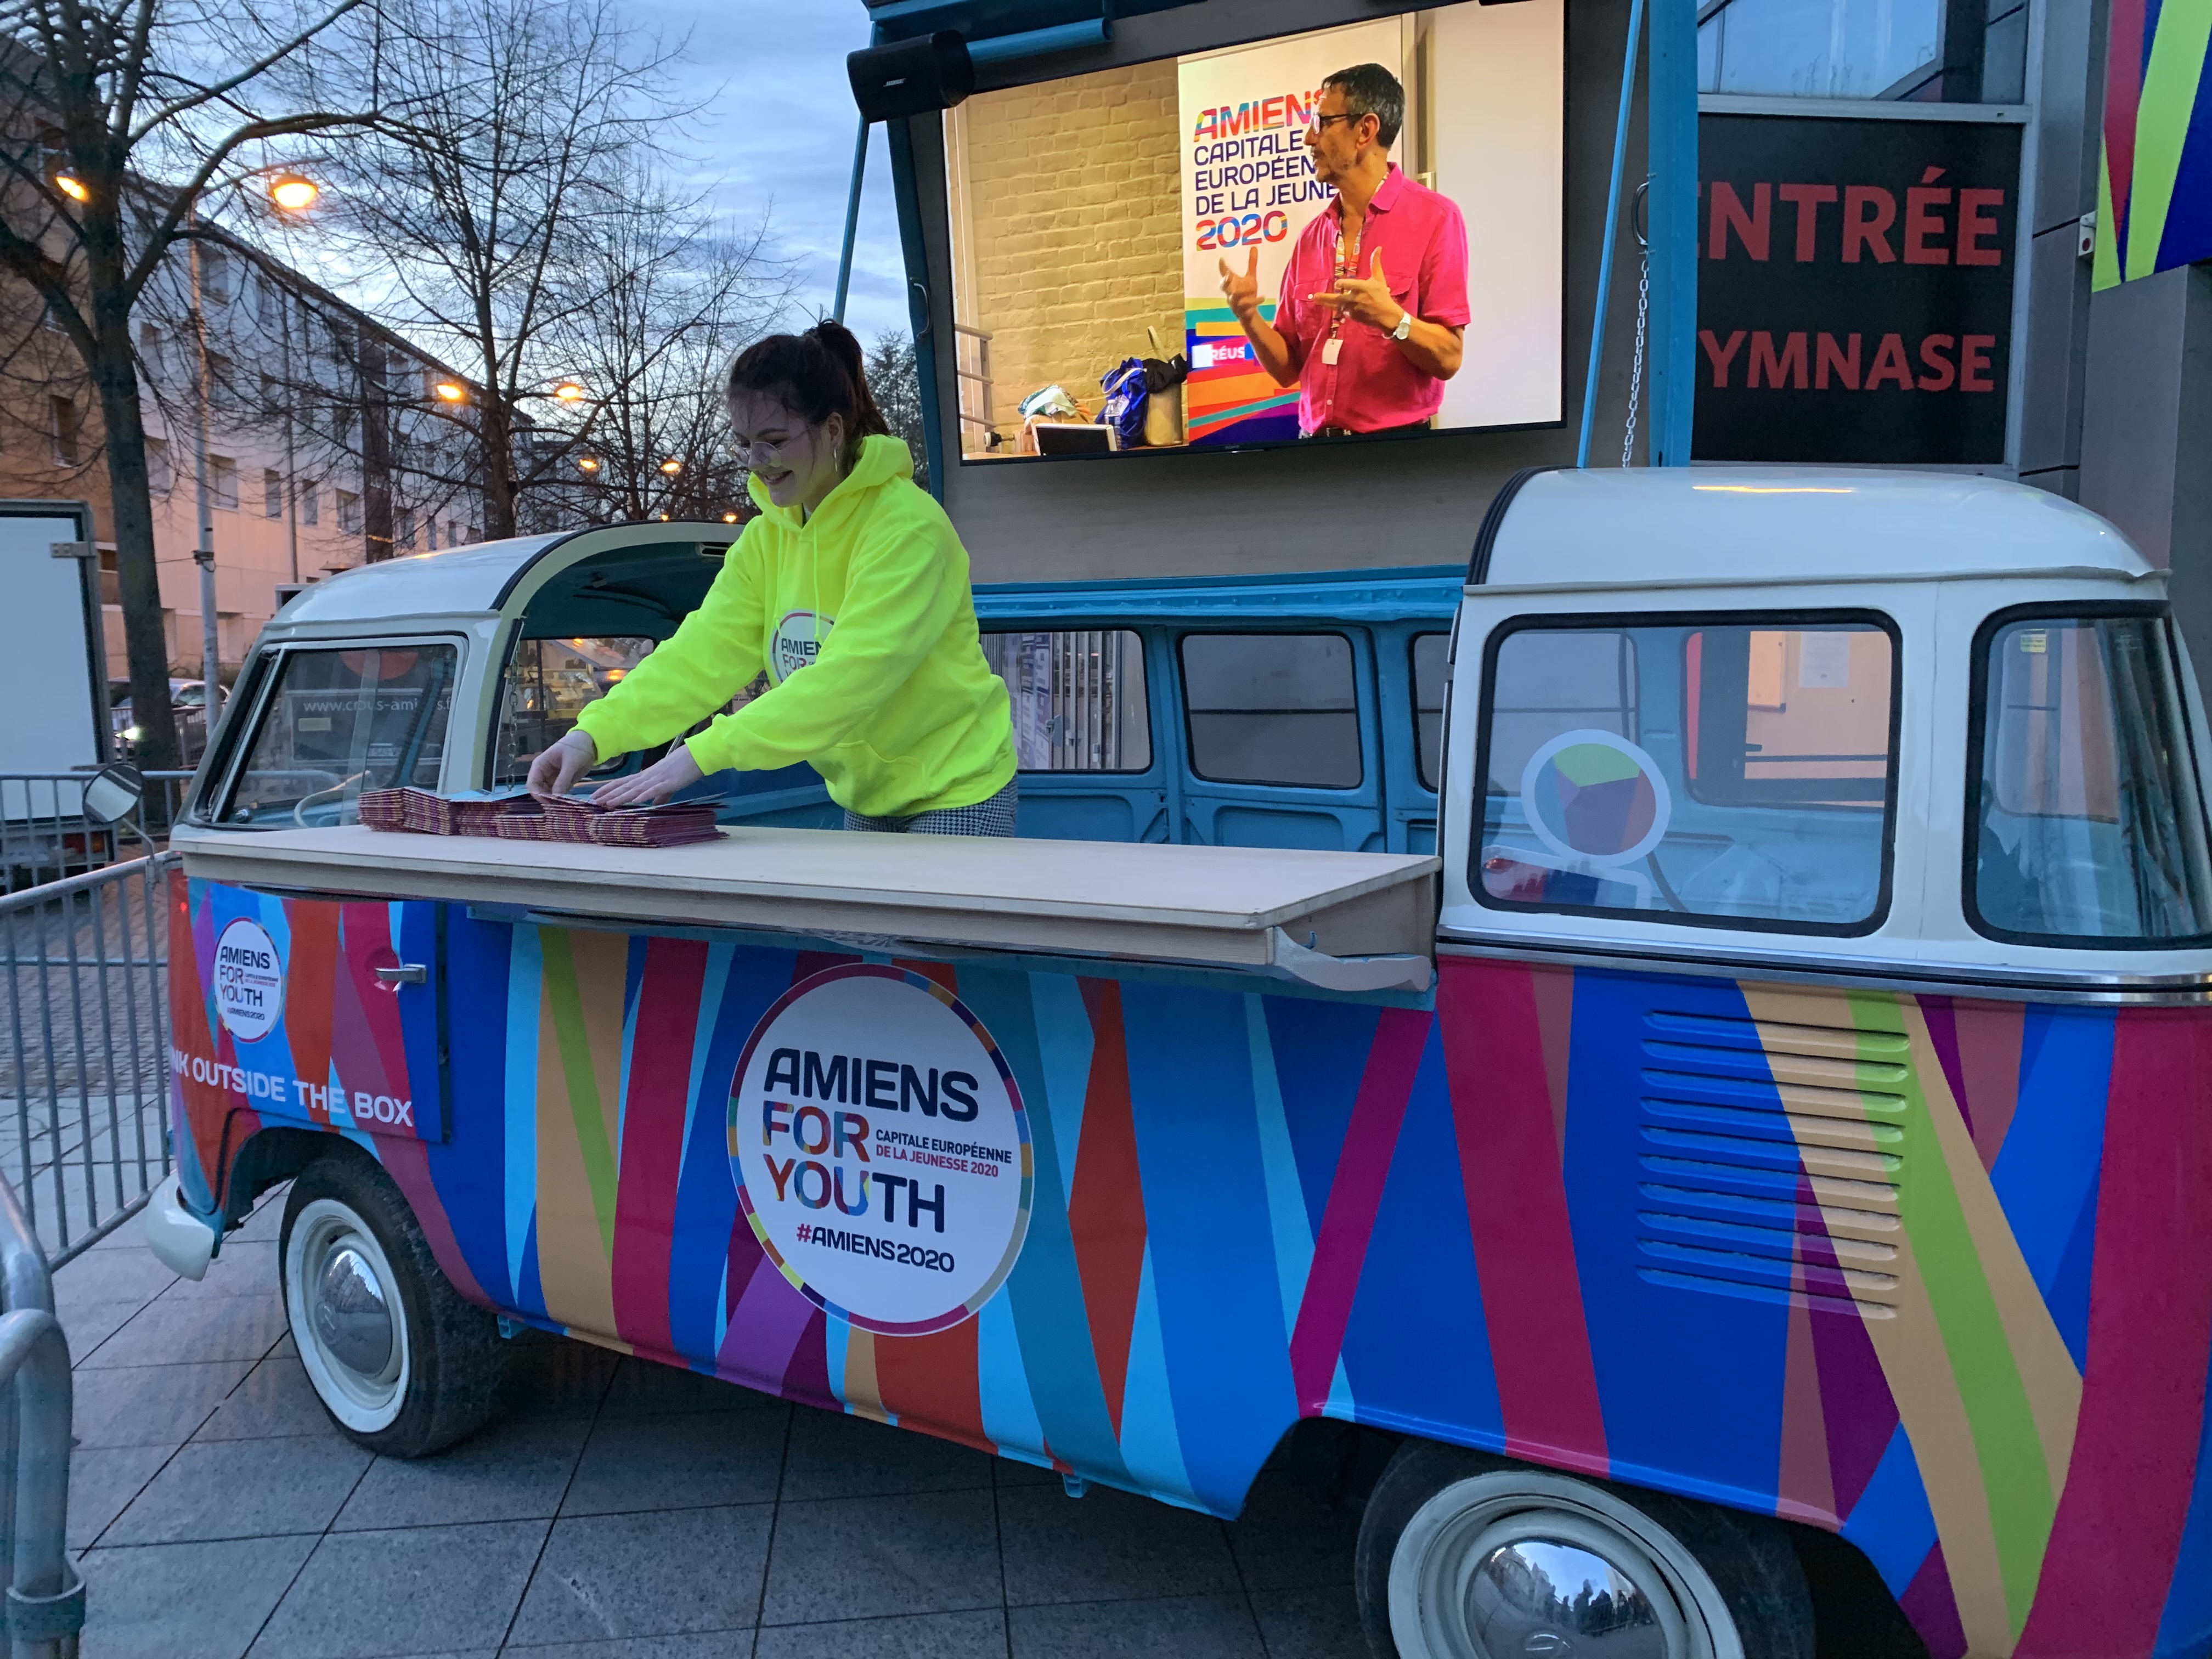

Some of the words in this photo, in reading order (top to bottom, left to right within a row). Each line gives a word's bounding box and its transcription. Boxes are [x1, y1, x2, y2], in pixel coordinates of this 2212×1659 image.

[1194, 129, 1304, 166] CAPITALE
[1196, 193, 1224, 216] DE
[1231, 188, 1260, 211] LA
[1697, 165, 2005, 266] NTRÉE
[1195, 210, 1288, 251] 2020
[782, 653, 807, 670] FOR
[219, 946, 270, 969] AMIENS
[219, 964, 244, 985] FOR
[219, 983, 263, 1007] YOUTH
[193, 1057, 286, 1102] OUTSIDE
[292, 1080, 346, 1113] THE
[354, 1092, 413, 1127] BOX
[763, 1047, 979, 1122] AMIENS
[762, 1099, 871, 1163] FOR
[876, 1129, 930, 1150] CAPITALE
[932, 1141, 1012, 1164] EUROPÉENNE
[876, 1144, 891, 1158] DE
[893, 1147, 908, 1161] LA
[909, 1150, 968, 1172] JEUNESSE
[970, 1161, 998, 1177] 2020
[762, 1153, 945, 1233] YOUTH
[796, 1223, 955, 1273] #AMIENS2020
